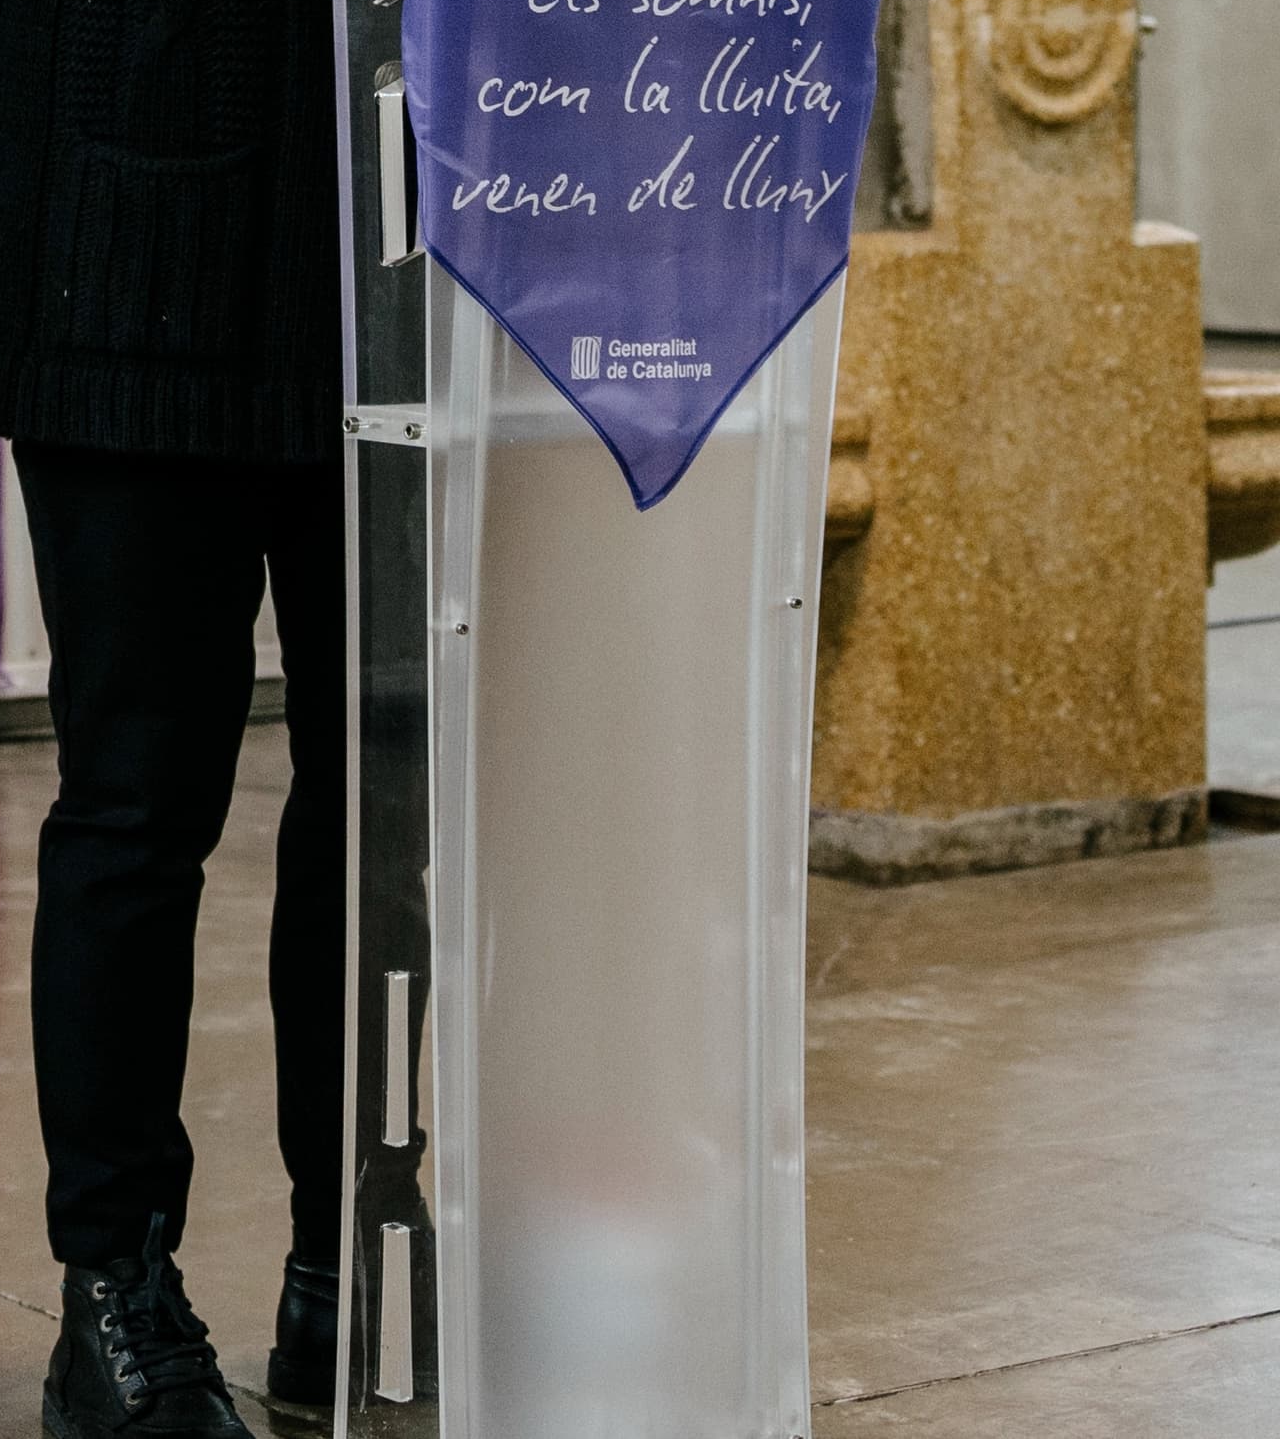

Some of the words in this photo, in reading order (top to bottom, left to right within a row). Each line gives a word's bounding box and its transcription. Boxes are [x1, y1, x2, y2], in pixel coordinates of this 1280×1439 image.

[476, 76, 592, 118] com
[623, 35, 672, 115] la
[698, 36, 843, 125] lluita,
[451, 172, 598, 217] venen
[626, 134, 698, 214] de
[722, 134, 847, 224] lluny
[606, 361, 628, 380] de
[631, 360, 713, 382] Catalunya
[607, 337, 698, 358] Generalitat
